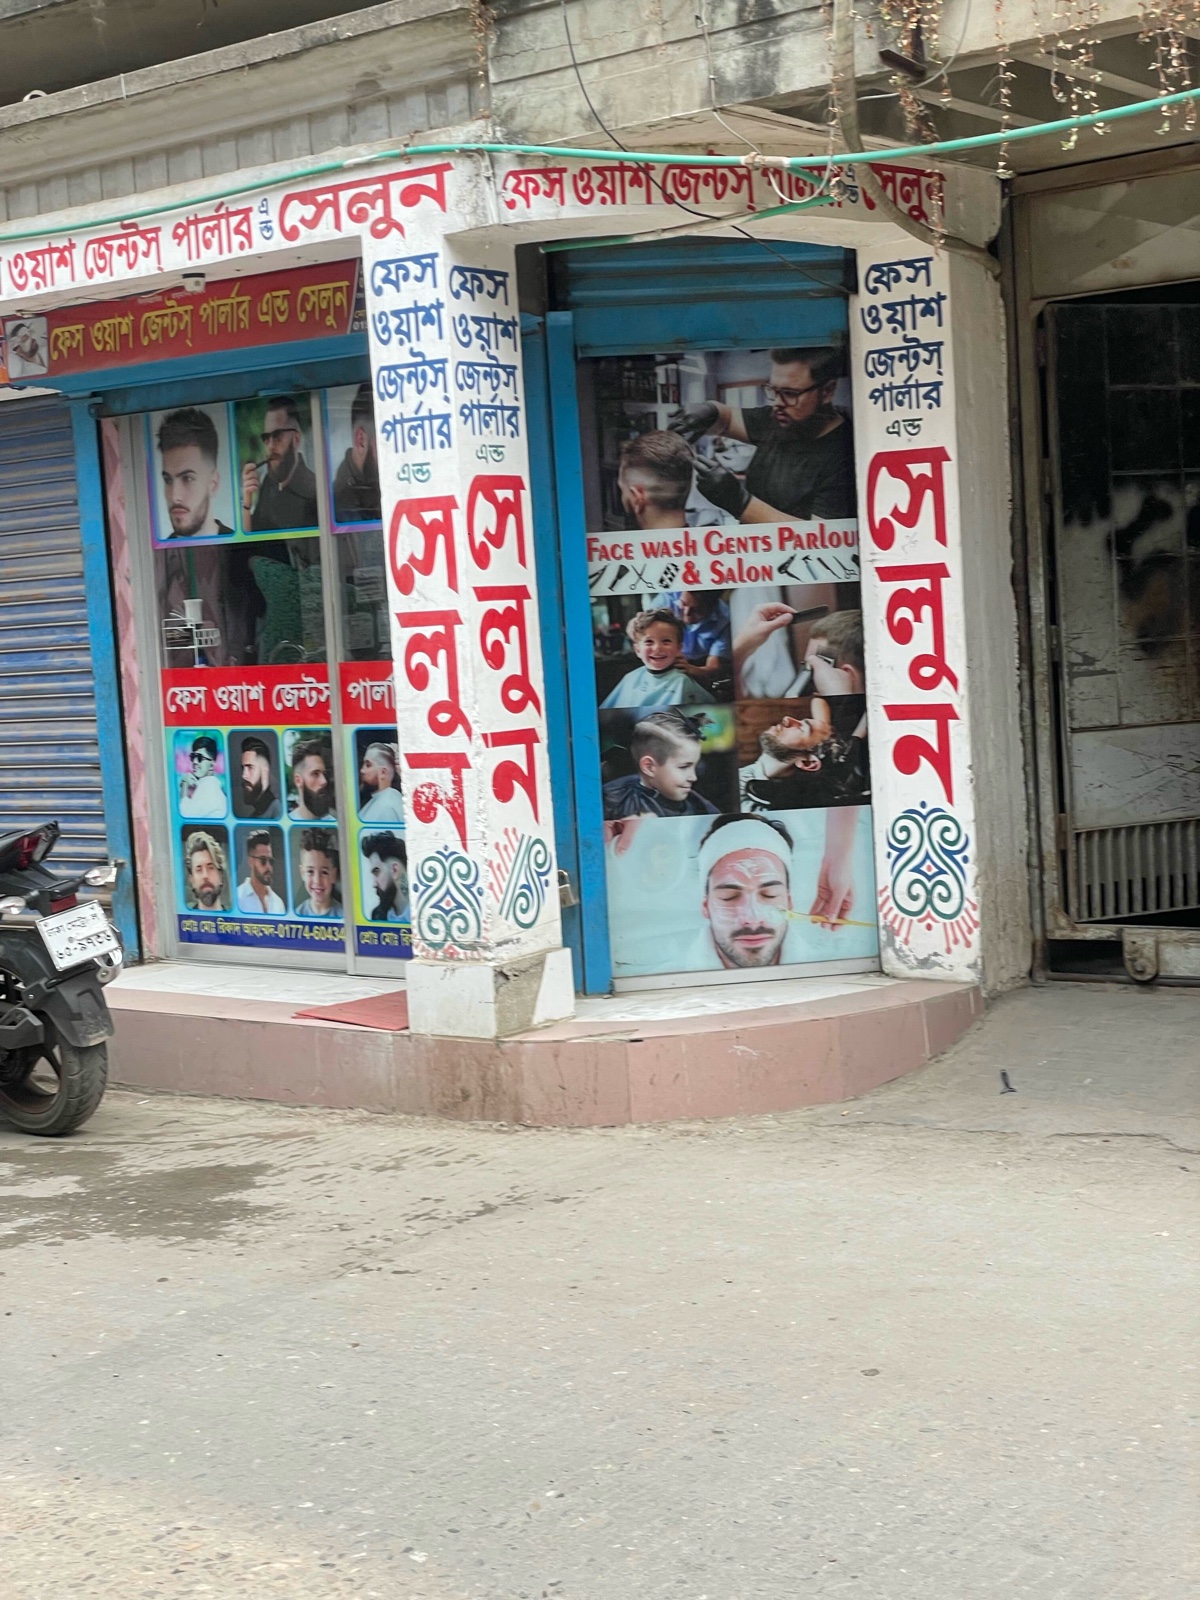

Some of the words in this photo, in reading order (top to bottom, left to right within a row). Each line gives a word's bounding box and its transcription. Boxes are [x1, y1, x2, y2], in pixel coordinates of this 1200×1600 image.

[501, 167, 567, 211] ফেস
[572, 160, 656, 206] ওয়াশ
[8, 238, 76, 291] ওয়াশ
[84, 222, 163, 280] জেন্টস্
[172, 202, 254, 262] পার্লার
[279, 163, 454, 240] সেলুন
[371, 252, 439, 297] ফেস
[450, 265, 509, 305] ফেস
[865, 257, 933, 295] ফেস
[50, 319, 85, 362] ফেস
[90, 311, 134, 353] ওয়াশ
[199, 282, 251, 336] পার্লার
[257, 289, 291, 327] এন্ড
[297, 281, 350, 330] সেলুন
[373, 298, 444, 346] ওয়াশ
[453, 312, 518, 352] ওয়াশ
[861, 291, 946, 335] ওয়াশ
[869, 373, 943, 412] পার্লার
[381, 401, 452, 453] পার্লার
[459, 393, 520, 438] পার্লার
[886, 418, 922, 437] এন্ড
[397, 462, 431, 484] এন্ড
[476, 443, 506, 463] এন্ড
[682, 560, 702, 585] &
[167, 686, 207, 713] ফেস
[213, 682, 266, 712] ওয়াশ
